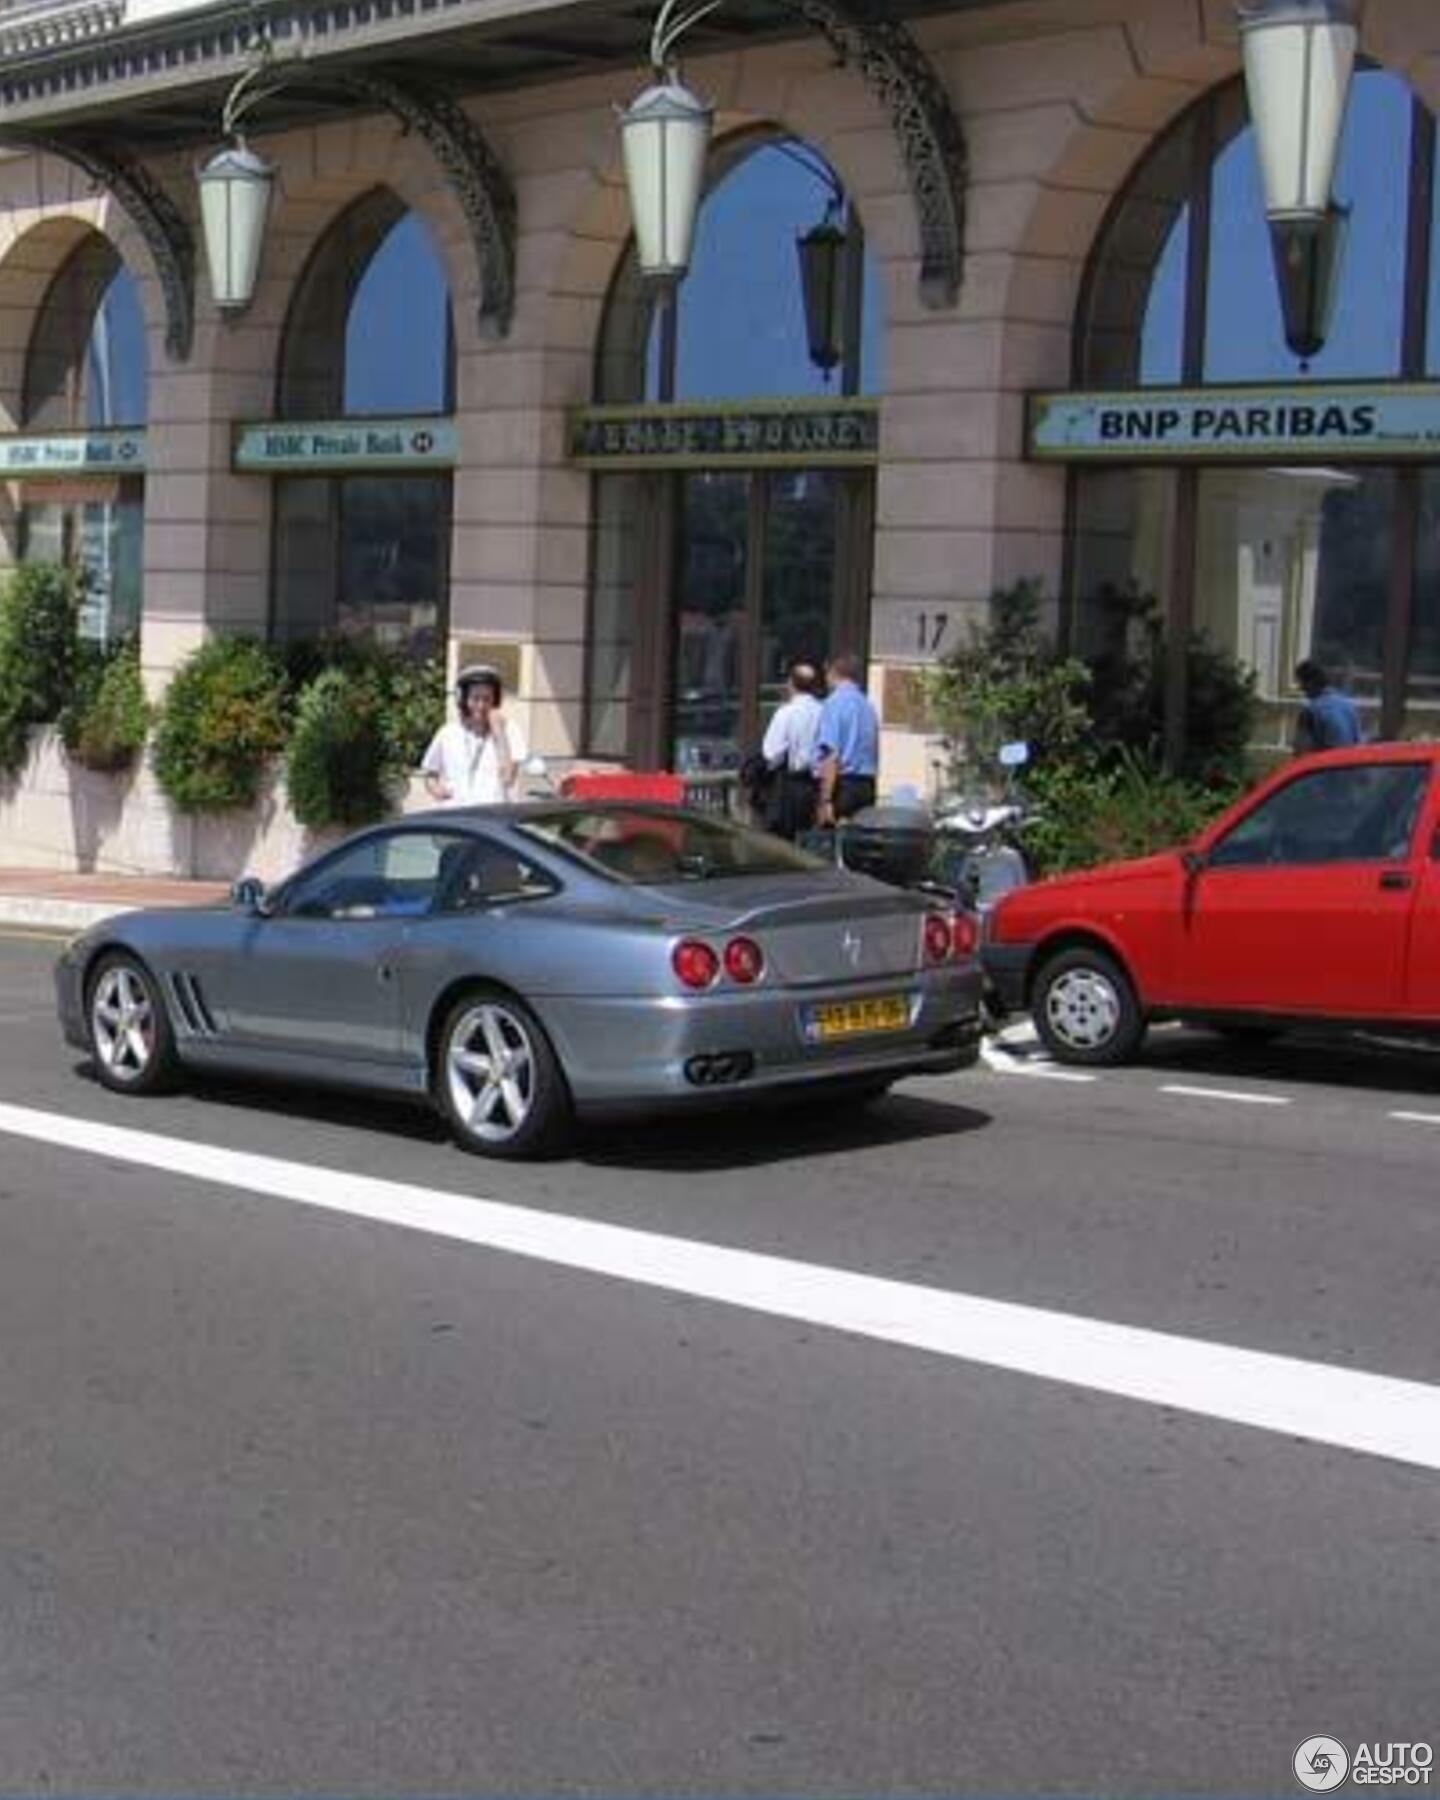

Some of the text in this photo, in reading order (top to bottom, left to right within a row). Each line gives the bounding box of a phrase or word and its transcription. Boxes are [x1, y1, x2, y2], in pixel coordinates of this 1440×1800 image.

[1099, 408, 1181, 439] BNP
[1191, 405, 1376, 438] PARIBAS
[918, 611, 948, 651] 17
